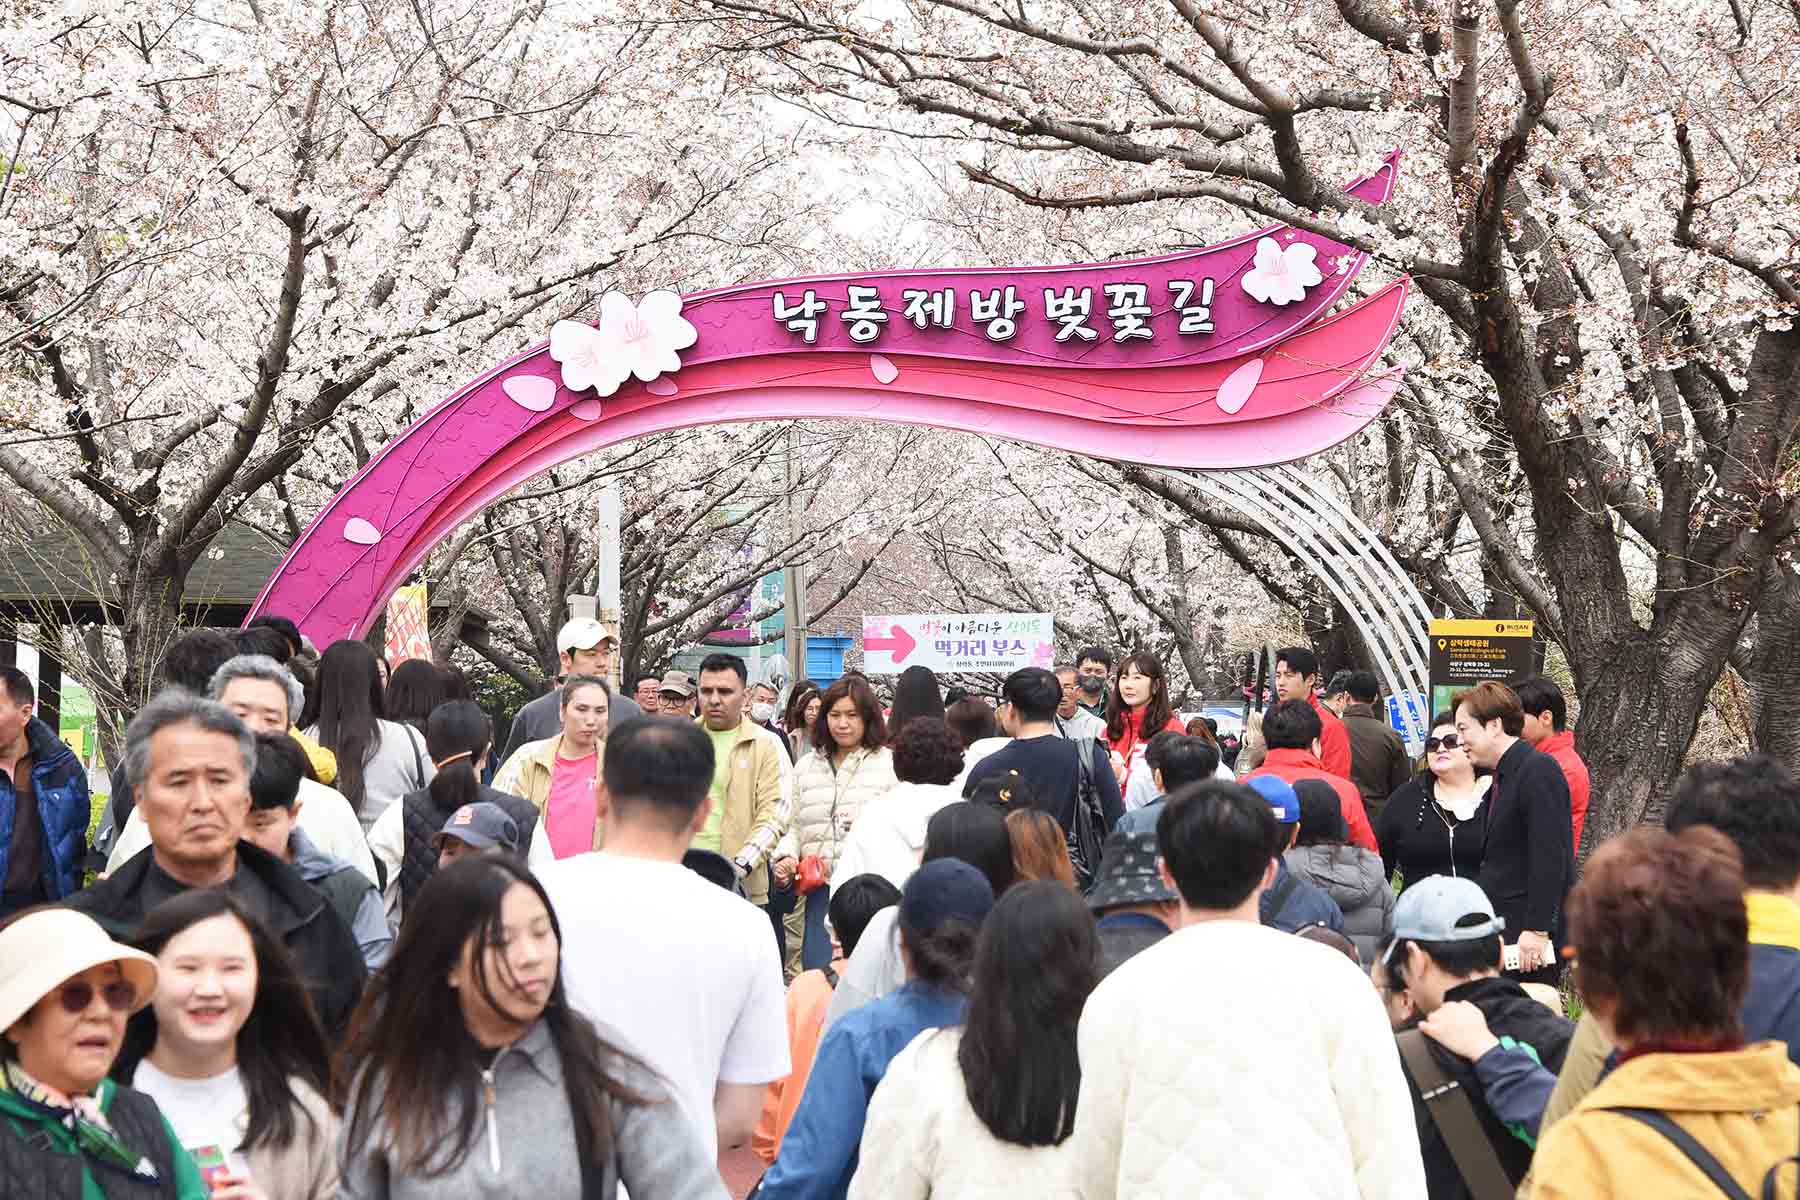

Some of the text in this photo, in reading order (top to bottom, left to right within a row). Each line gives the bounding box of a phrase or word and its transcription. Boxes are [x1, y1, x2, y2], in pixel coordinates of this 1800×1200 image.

[772, 276, 1215, 344] 낙동제방 벚꽃길
[919, 619, 951, 637] 벚꽃이
[955, 619, 1003, 636] 아름다운
[934, 639, 1027, 657] 먹거리 부스
